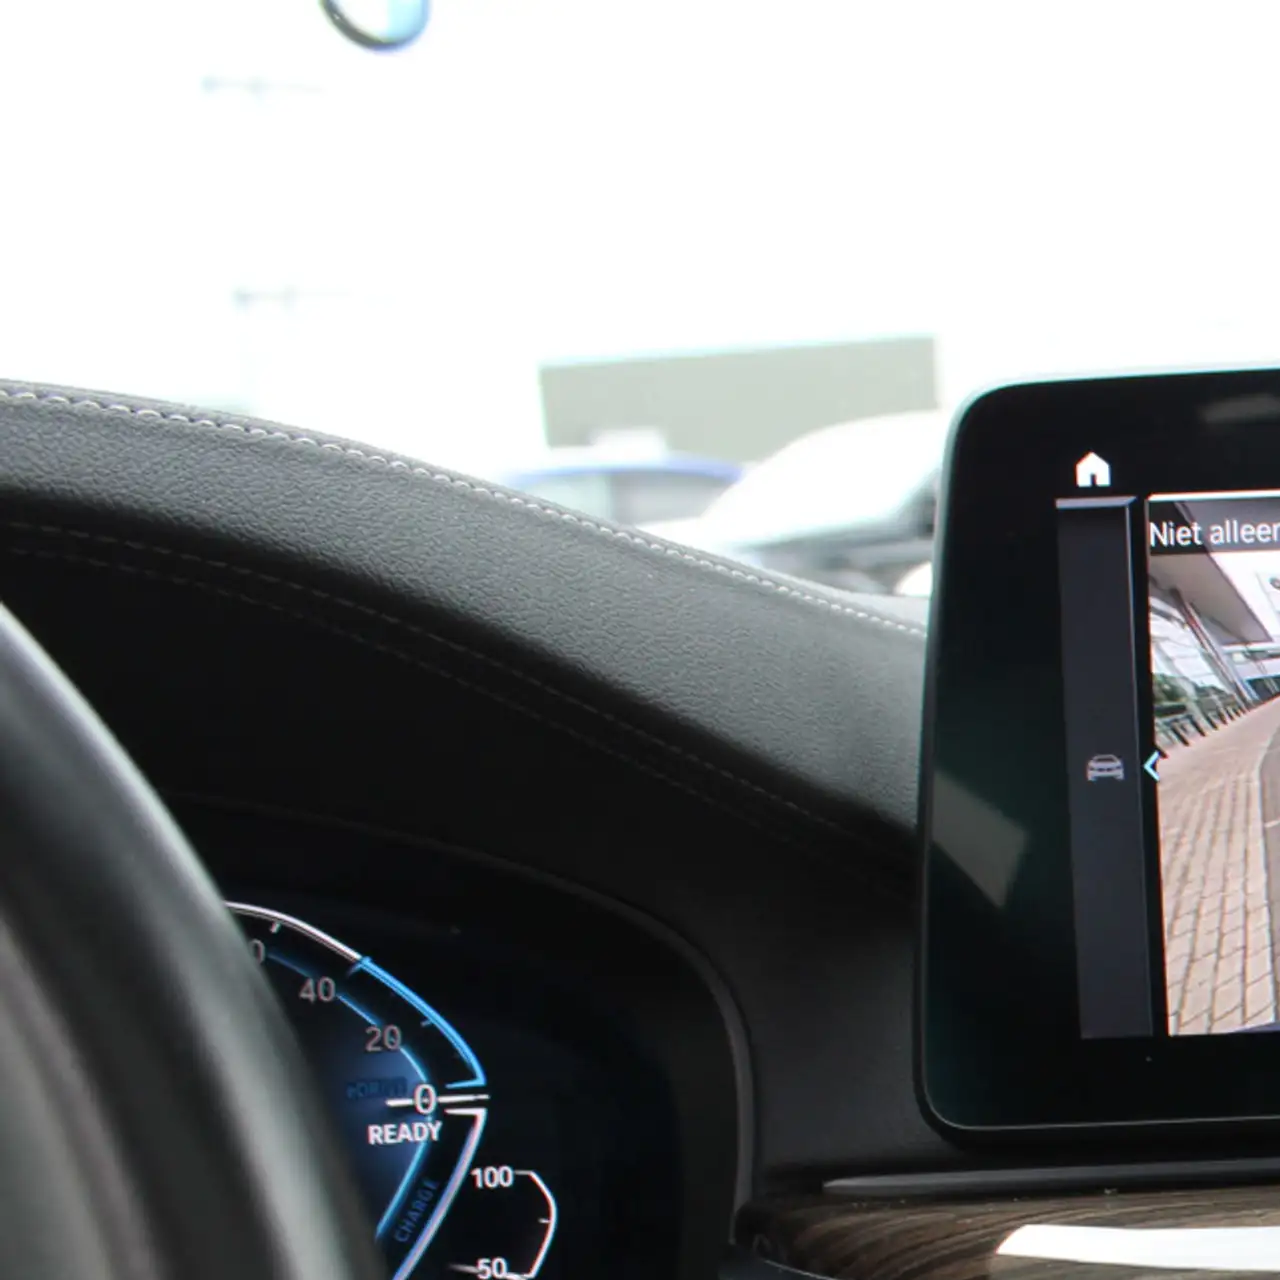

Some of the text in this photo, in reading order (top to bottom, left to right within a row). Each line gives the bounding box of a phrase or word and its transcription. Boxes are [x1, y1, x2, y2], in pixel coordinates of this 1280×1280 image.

[1148, 520, 1202, 547] Niet
[299, 975, 336, 1003] 40
[365, 1024, 401, 1052] 20
[414, 1083, 437, 1114] 0
[367, 1120, 443, 1146] READY
[470, 1165, 514, 1188] 100
[395, 1178, 441, 1243] CHARGE
[476, 1257, 508, 1280] 50
